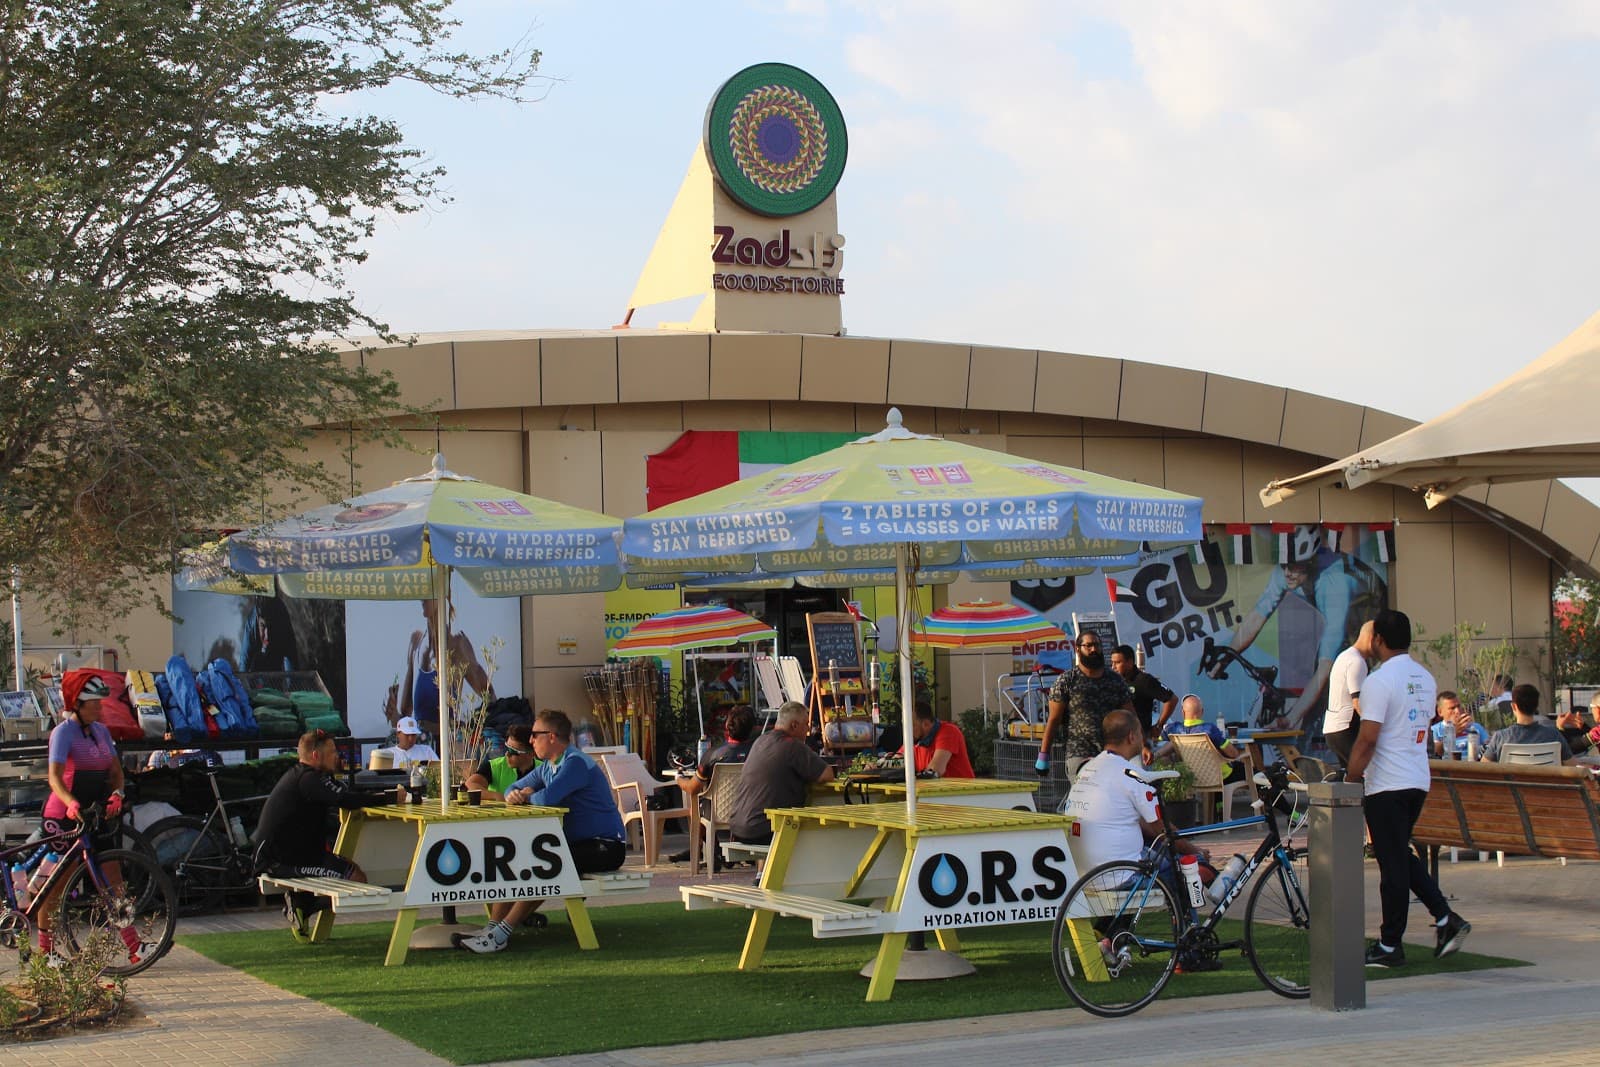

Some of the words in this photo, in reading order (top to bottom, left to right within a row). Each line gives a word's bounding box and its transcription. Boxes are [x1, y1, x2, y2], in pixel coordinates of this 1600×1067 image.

[711, 225, 790, 268] Zad
[841, 507, 853, 521] 2
[862, 502, 951, 519] TABLETS
[962, 501, 989, 517] OF
[1000, 499, 1058, 516] O.R.S
[1096, 501, 1125, 516] STAY
[651, 520, 688, 537] STAY
[697, 510, 794, 531] HYDRATED.
[860, 522, 871, 535] 5
[876, 518, 959, 536] GLASSES
[966, 518, 990, 533] OF
[996, 515, 1059, 532] WATER
[1097, 516, 1123, 531] STAY
[455, 531, 496, 545] STAY
[507, 532, 601, 547] HYDRATED.
[653, 536, 690, 553] STAY
[699, 527, 797, 549] REFRESHED.
[454, 545, 496, 559] STAY
[505, 547, 601, 561] REFRESHED.
[1130, 540, 1227, 624] GU
[1141, 614, 1206, 658] FOR
[1206, 600, 1243, 633] IT.
[425, 832, 563, 886] O.R.S
[917, 845, 1067, 909] O.R.S
[1214, 857, 1259, 916] TREK
[431, 887, 507, 902] HYDRATION
[511, 885, 561, 897] TABLETS
[924, 909, 1006, 927] HYDRATION
[1011, 906, 1059, 921] TABLET
